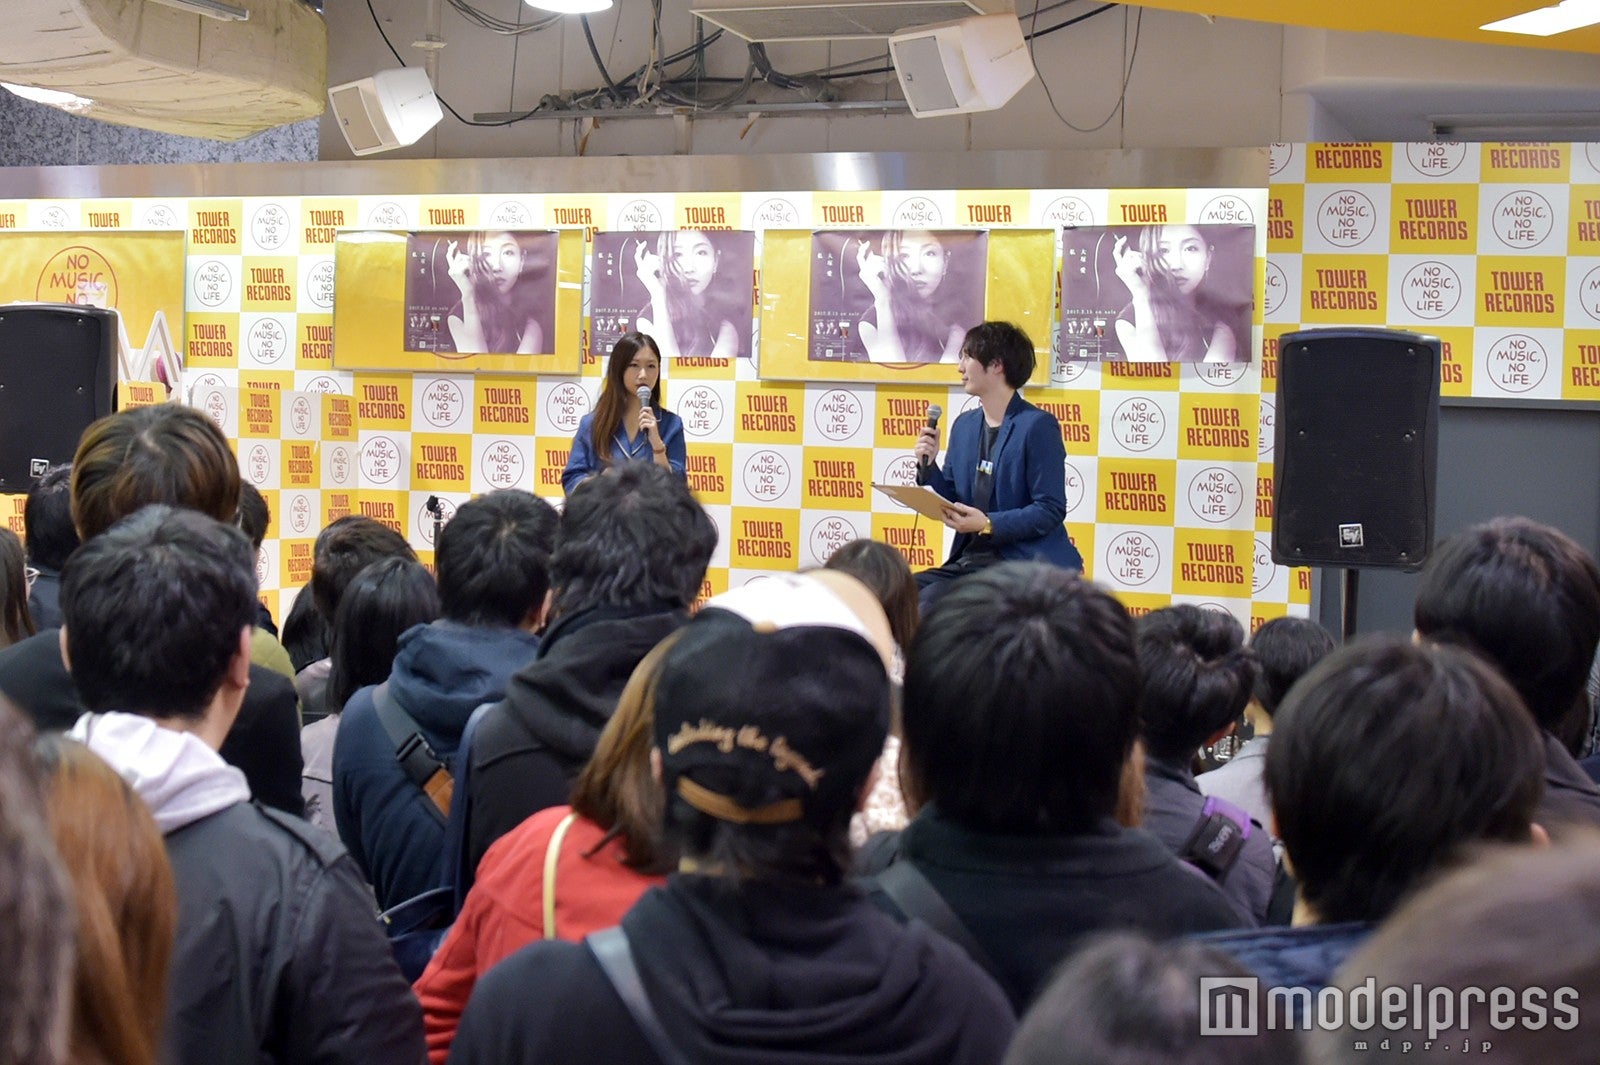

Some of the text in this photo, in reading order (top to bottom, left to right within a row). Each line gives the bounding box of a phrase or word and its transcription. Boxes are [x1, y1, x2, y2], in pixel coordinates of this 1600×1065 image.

[1316, 150, 1382, 168] RECORDS
[1428, 147, 1444, 156] NO
[1490, 149, 1560, 168] RECORDS
[911, 202, 925, 210] NO
[1062, 202, 1076, 210] NO
[1220, 201, 1234, 209] NO
[1339, 196, 1356, 204] NO
[429, 209, 464, 224] TOWER
[554, 208, 592, 224] TOWER
[685, 207, 724, 223] TOWER
[822, 206, 864, 222] TOWER
[968, 205, 1011, 222] TOWER
[1121, 205, 1167, 222] TOWER
[1406, 200, 1457, 218] TOWER
[88, 213, 119, 227] TOWER
[197, 212, 229, 226] TOWER
[310, 210, 344, 226] TOWER
[1338, 218, 1355, 227] NO
[193, 229, 236, 244] RECORDS
[1399, 221, 1467, 240] RECORDS
[67, 254, 89, 270] NO
[251, 268, 284, 283] TOWER
[1316, 270, 1367, 288] TOWER
[1424, 267, 1440, 276] NO
[1491, 272, 1544, 291] TOWER
[247, 286, 290, 300] RECORDS
[1310, 290, 1377, 310] RECORDS
[1423, 290, 1440, 299] NO
[1485, 293, 1554, 313] RECORDS
[193, 324, 226, 339] TOWER
[307, 326, 332, 341] TOWE
[190, 341, 232, 356] RECORDS
[1510, 340, 1526, 349] NO
[1111, 362, 1172, 378] RECORDS
[1509, 363, 1526, 372] NO
[130, 386, 154, 402] TOWER
[250, 394, 269, 407] TOWER
[363, 385, 398, 401] TOWER
[484, 388, 521, 404] TOWER
[332, 399, 349, 412] TOWER
[359, 402, 405, 419] RECORDS
[747, 395, 787, 412] TOWER
[887, 399, 929, 416] TOWER
[247, 409, 272, 422] RECORDS
[329, 413, 352, 426] RECORDS
[480, 406, 528, 423] RECORDS
[1193, 408, 1240, 426] TOWER
[742, 414, 796, 432] RECORDS
[1187, 428, 1249, 447] RECORDS
[292, 446, 310, 458] TOWER
[421, 446, 456, 462] TOWER
[761, 456, 774, 464] NO
[288, 460, 312, 473] RECORDS
[417, 463, 464, 480] RECORDS
[686, 456, 716, 472] OWER
[814, 460, 855, 478] TOWER
[688, 474, 724, 492] CORDS
[760, 476, 773, 484] NO
[1111, 472, 1156, 491] TOWER
[1209, 473, 1224, 482] NO
[808, 480, 864, 498] RECORDS
[331, 495, 348, 507] TOWER
[1105, 492, 1166, 512] RECORDS
[1208, 495, 1223, 503] NO
[359, 502, 394, 518] TOWER
[743, 520, 783, 538] TOWER
[828, 522, 842, 530] NO
[883, 528, 926, 546] TOWER
[1126, 537, 1142, 545] NO
[738, 539, 791, 558] RECORDS
[827, 542, 841, 550] NO
[1187, 543, 1234, 563] TOWER
[1126, 558, 1140, 566] NO
[1182, 563, 1244, 584] RECORDS
